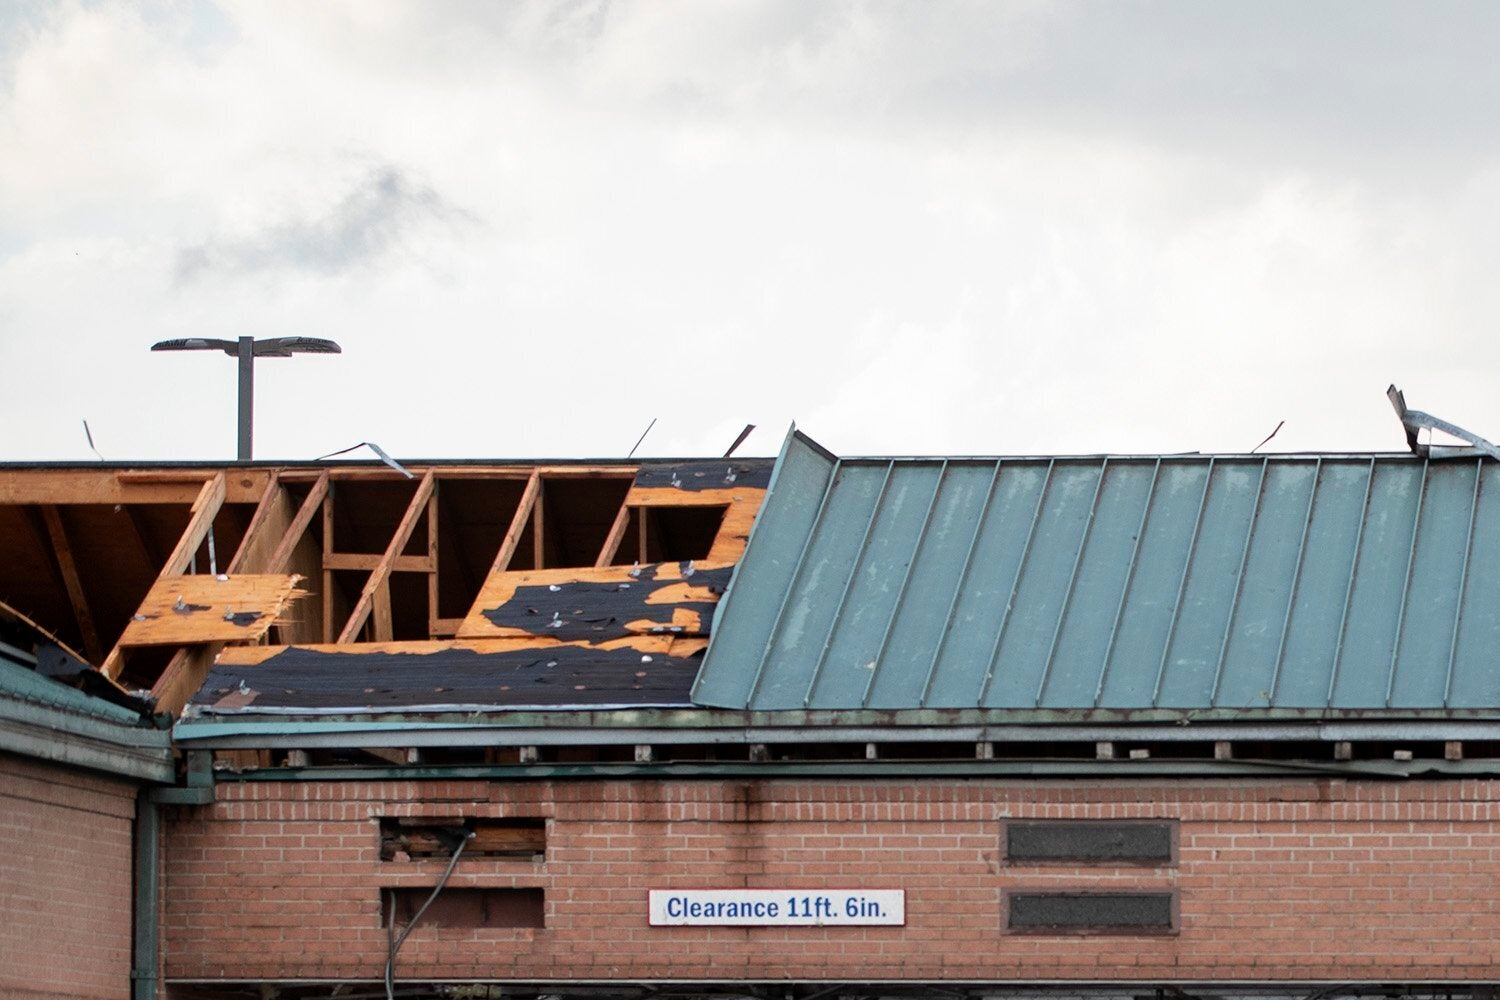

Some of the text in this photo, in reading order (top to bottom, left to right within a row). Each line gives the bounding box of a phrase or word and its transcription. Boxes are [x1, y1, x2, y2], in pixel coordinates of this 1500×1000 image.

[667, 897, 887, 918] Clearance 11ft. 6in.
